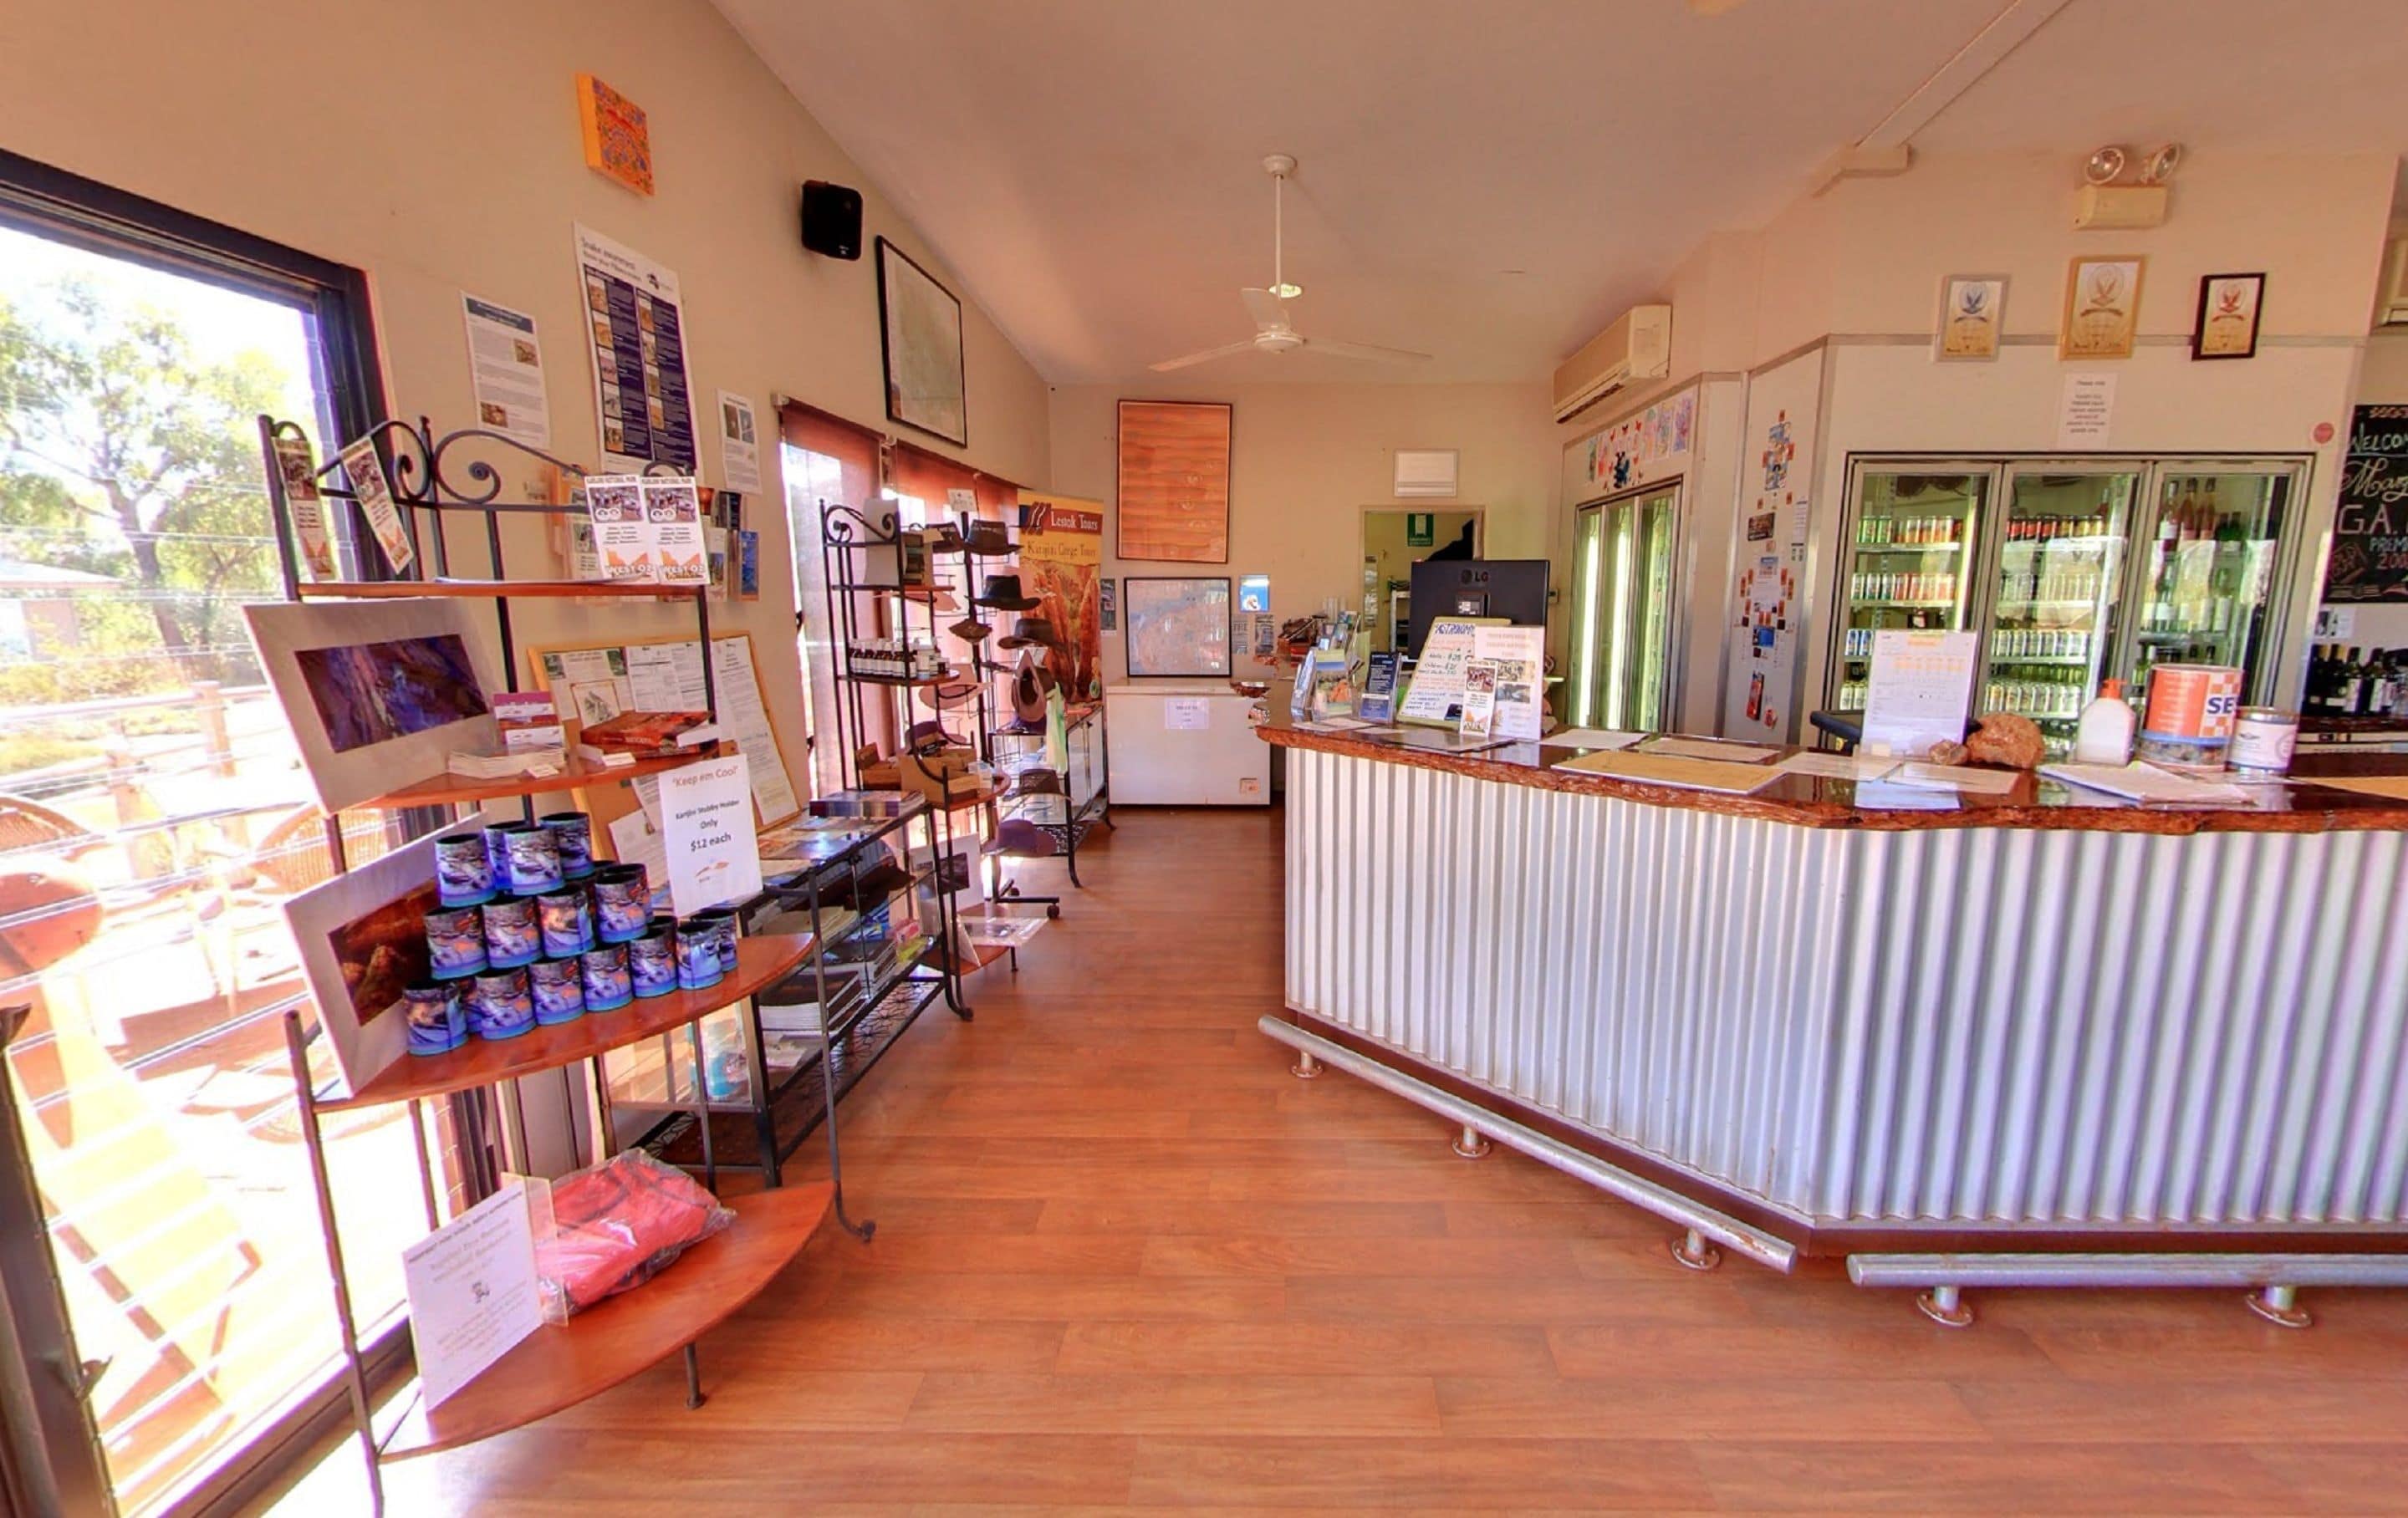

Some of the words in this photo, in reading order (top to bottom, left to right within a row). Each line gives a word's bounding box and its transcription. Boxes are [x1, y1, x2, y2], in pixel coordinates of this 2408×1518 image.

[1051, 511, 1077, 528] Lestok
[1078, 514, 1099, 531] Tours
[1475, 570, 1489, 583] LG
[700, 772, 714, 782] em
[699, 818, 719, 830] Only
[690, 838, 707, 853] $12
[708, 833, 732, 846] each
